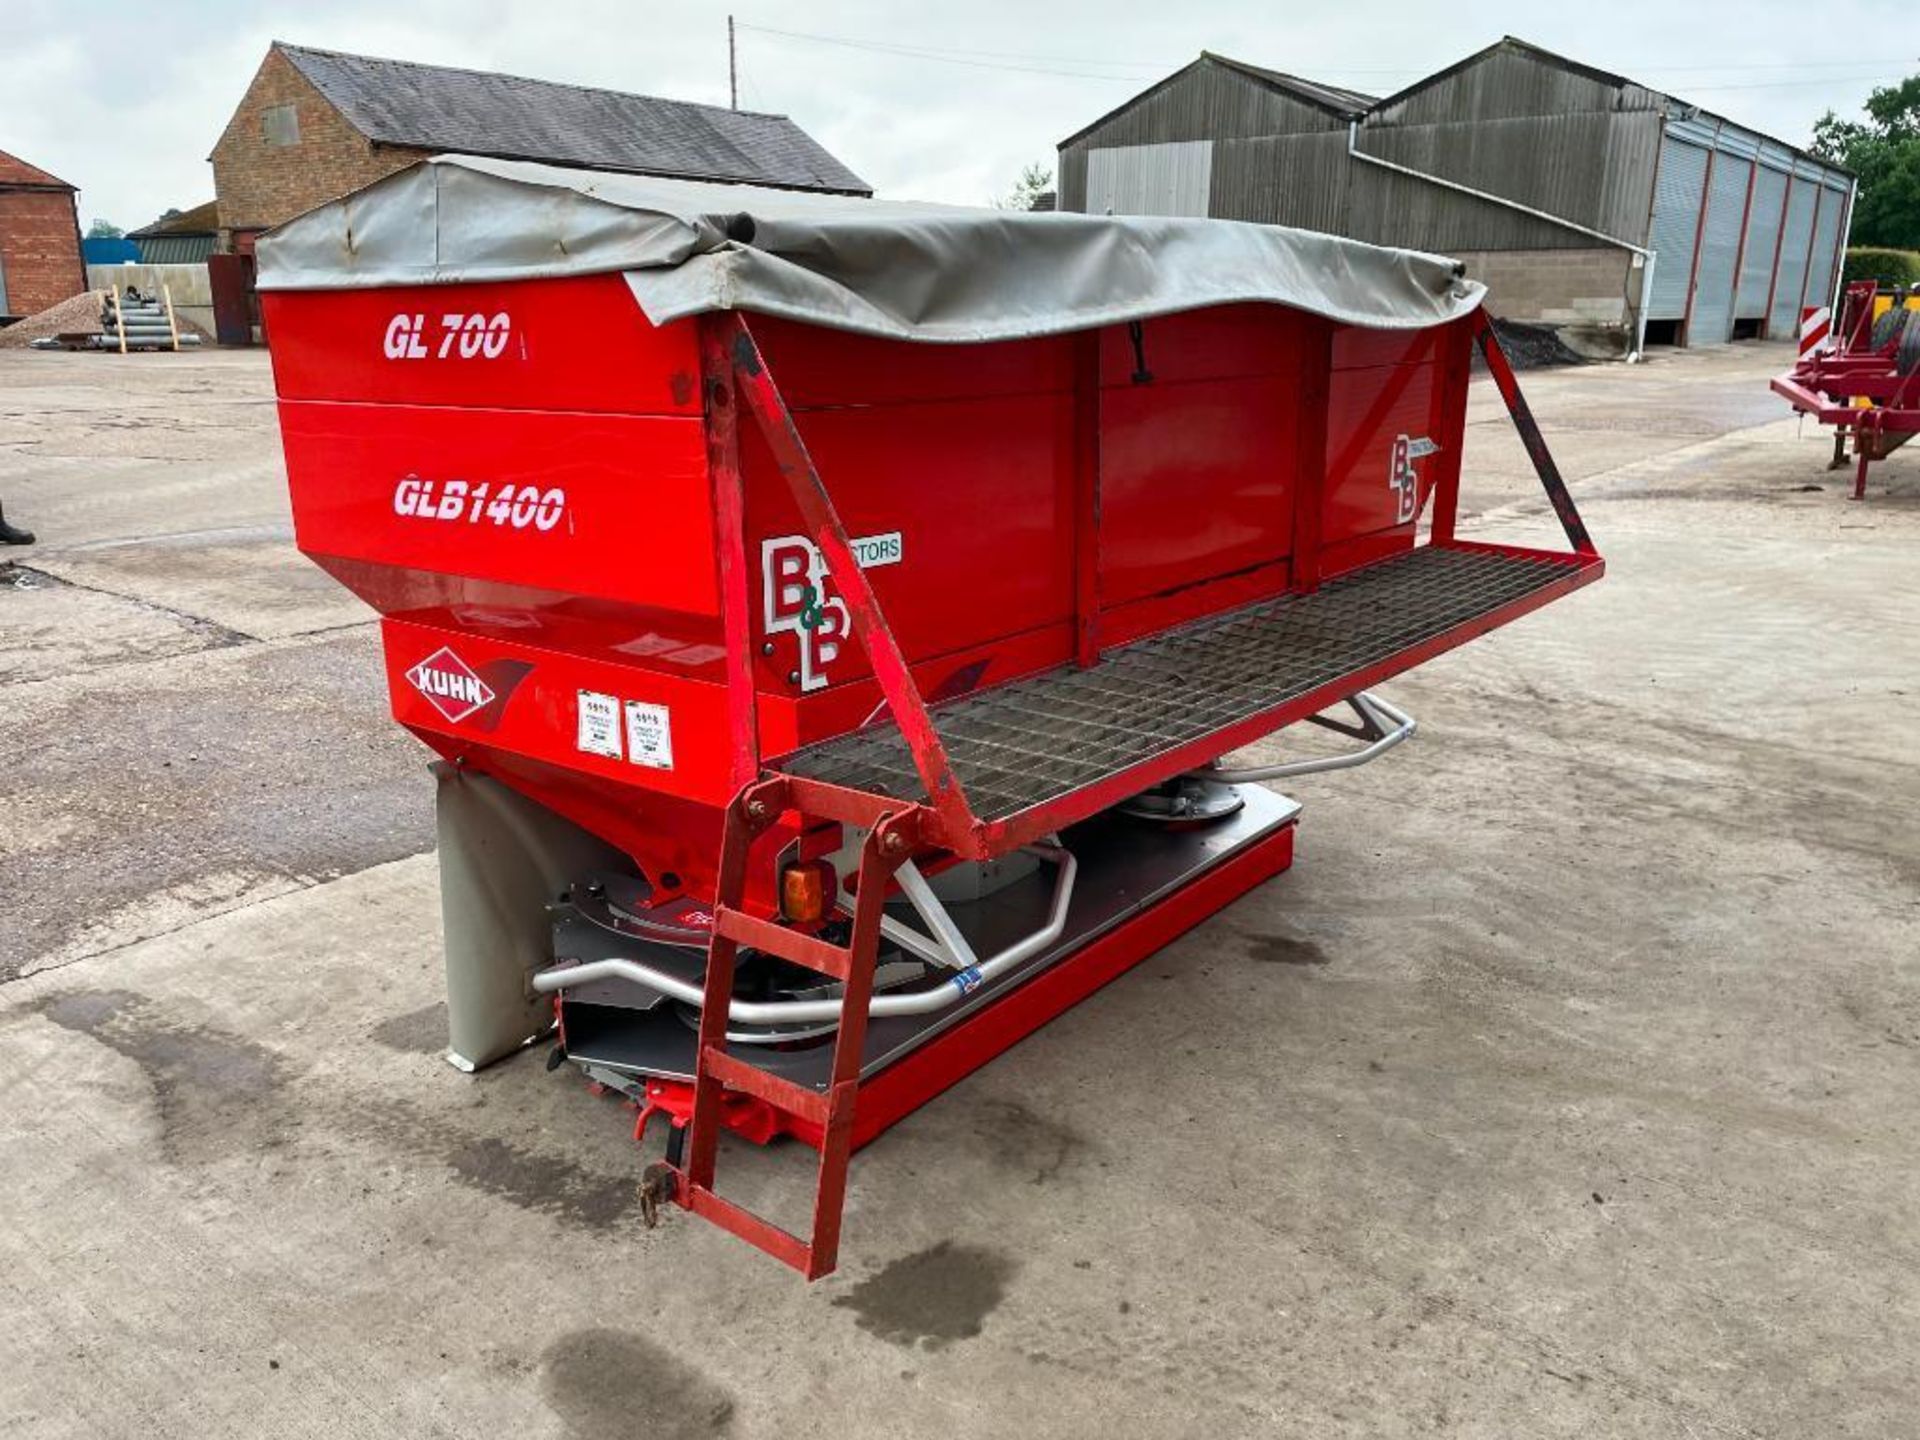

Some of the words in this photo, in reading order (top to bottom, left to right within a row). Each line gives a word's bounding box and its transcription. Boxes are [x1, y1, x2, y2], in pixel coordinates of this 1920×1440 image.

[384, 313, 428, 359] GL
[437, 312, 511, 359] 700
[394, 479, 565, 531] GLB1400
[418, 666, 483, 705] KUHN
